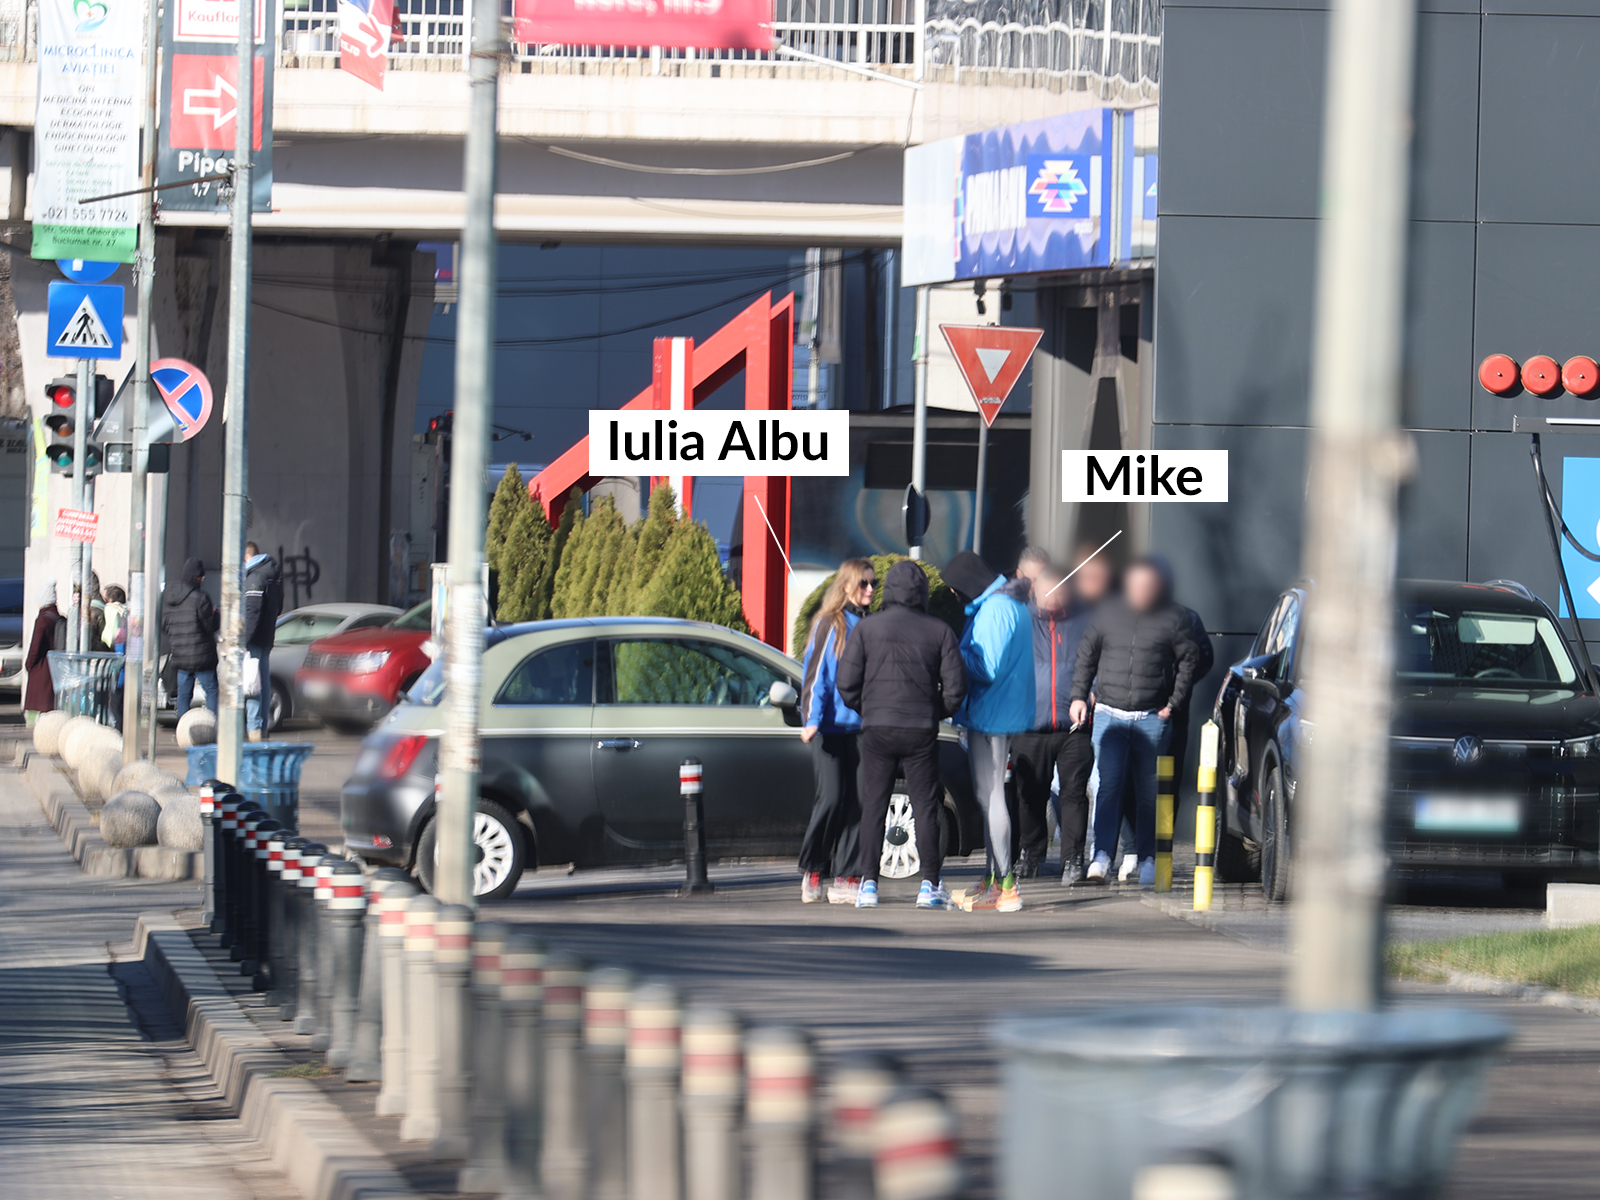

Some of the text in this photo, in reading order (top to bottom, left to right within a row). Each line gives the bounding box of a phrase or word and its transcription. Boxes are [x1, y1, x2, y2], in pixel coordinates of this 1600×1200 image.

[187, 10, 240, 23] Kauflan
[43, 44, 135, 58] MICROCLINICA
[60, 107, 115, 118] ECOGRAFIE
[50, 119, 125, 130] DERMATOLOGIE
[45, 131, 129, 142] ENDOCRINOLOGIE
[54, 143, 118, 154] GINECOLOGIE
[192, 181, 211, 197] 1,7
[47, 206, 68, 219] 021
[72, 208, 95, 221] 555
